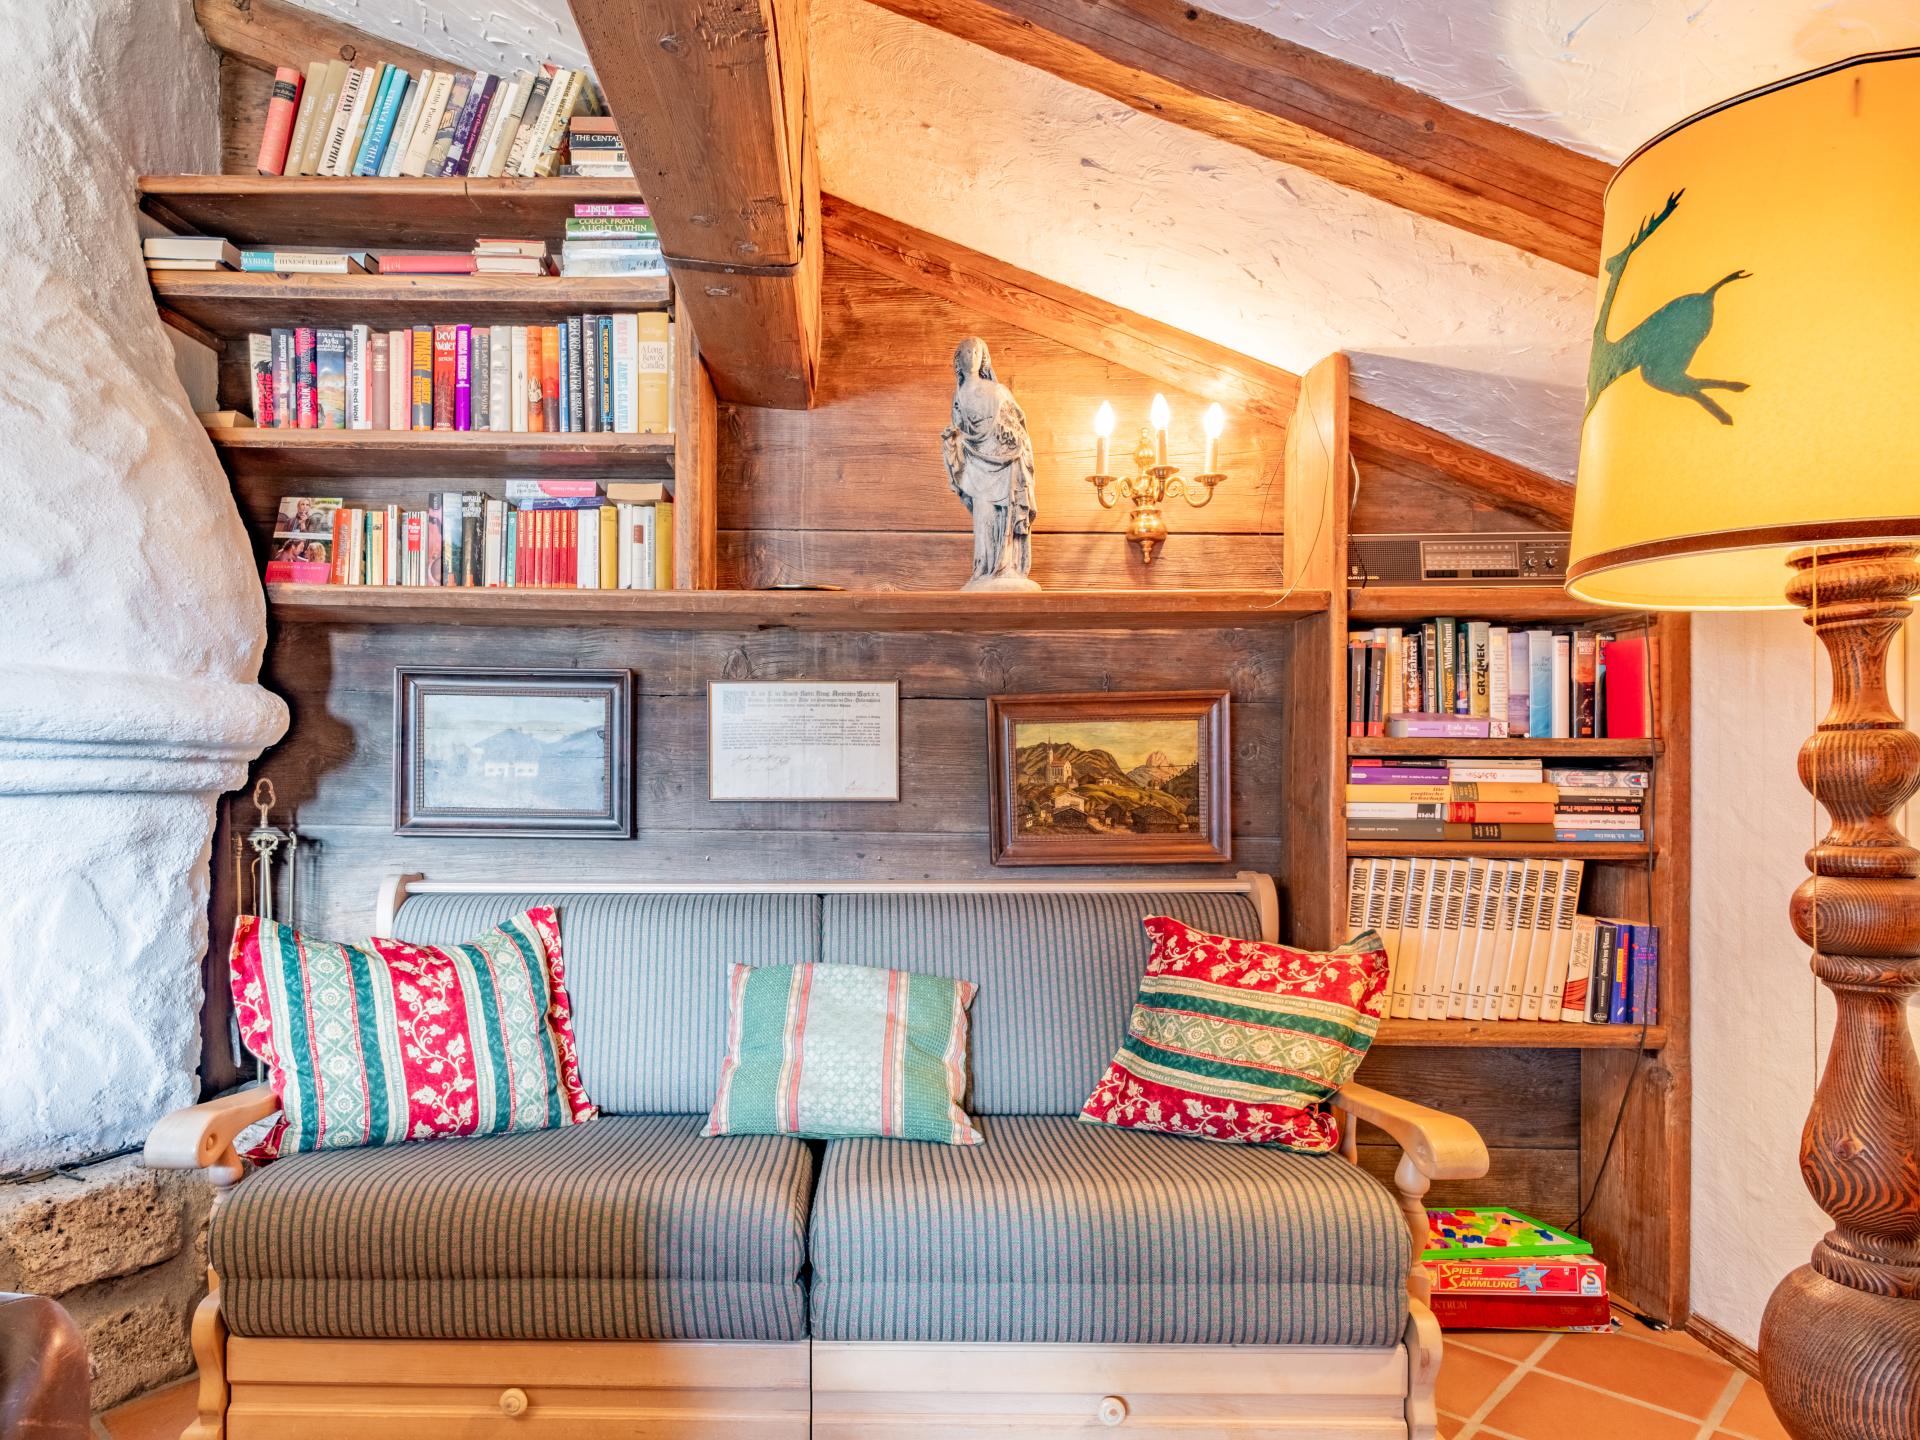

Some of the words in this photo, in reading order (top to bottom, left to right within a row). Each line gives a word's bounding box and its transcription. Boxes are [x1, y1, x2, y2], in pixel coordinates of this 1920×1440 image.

[351, 70, 364, 91] THE
[563, 71, 577, 97] MORRIS
[343, 93, 354, 113] DAY
[556, 98, 567, 118] WEST
[327, 127, 346, 169] DOLPHIN
[366, 144, 379, 164] THE
[615, 224, 647, 232] WITHIN
[457, 331, 468, 354] MONICA
[481, 334, 489, 348] THE
[568, 318, 581, 350] BEFORE
[413, 331, 432, 371] DYNASTY
[481, 350, 489, 367] LAST
[586, 337, 594, 365] SENSE
[457, 355, 468, 380] DICKENS
[569, 363, 581, 390] AFTER
[587, 367, 594, 378] OF
[618, 361, 628, 391] JAMES
[641, 361, 665, 370] Candles
[413, 376, 422, 405] ELEGANT
[422, 377, 432, 405] ROBERT
[480, 380, 489, 393] THE
[480, 395, 489, 415] WINE
[617, 393, 628, 431] CLAVELL
[1443, 622, 1453, 669] Waldheimat
[1408, 641, 1417, 688] Seefahrer
[1444, 672, 1454, 709] Rosegger
[1352, 868, 1367, 890] 2000
[1373, 868, 1388, 891] 2000
[1391, 870, 1406, 892] 2000
[1411, 869, 1426, 891] 2000
[1432, 870, 1447, 891] 2000
[1451, 870, 1466, 892] 2000
[1469, 868, 1484, 890] 2000
[1488, 870, 1503, 892] 2000
[1507, 871, 1521, 893] 2000
[1523, 870, 1539, 891] 2000
[1543, 870, 1558, 892] 2000
[1564, 870, 1579, 891] 2000
[1349, 891, 1365, 928] LEXIKON
[1368, 892, 1383, 928] LEXIKON
[1386, 893, 1403, 929] LEXIKON
[1405, 892, 1421, 928] LEXIKON
[1427, 893, 1443, 929] LEXIKON
[1444, 893, 1462, 930] LEXIKON
[1463, 891, 1480, 928] LEXIKON
[1482, 893, 1498, 930] LEXIKON
[1518, 893, 1534, 929] LEXIKON
[1537, 893, 1554, 930] LEXIKON
[1557, 893, 1575, 930] LEXIKON
[1441, 1263, 1483, 1278] SPIELE
[1449, 1275, 1518, 1290] SAMMLUNG
